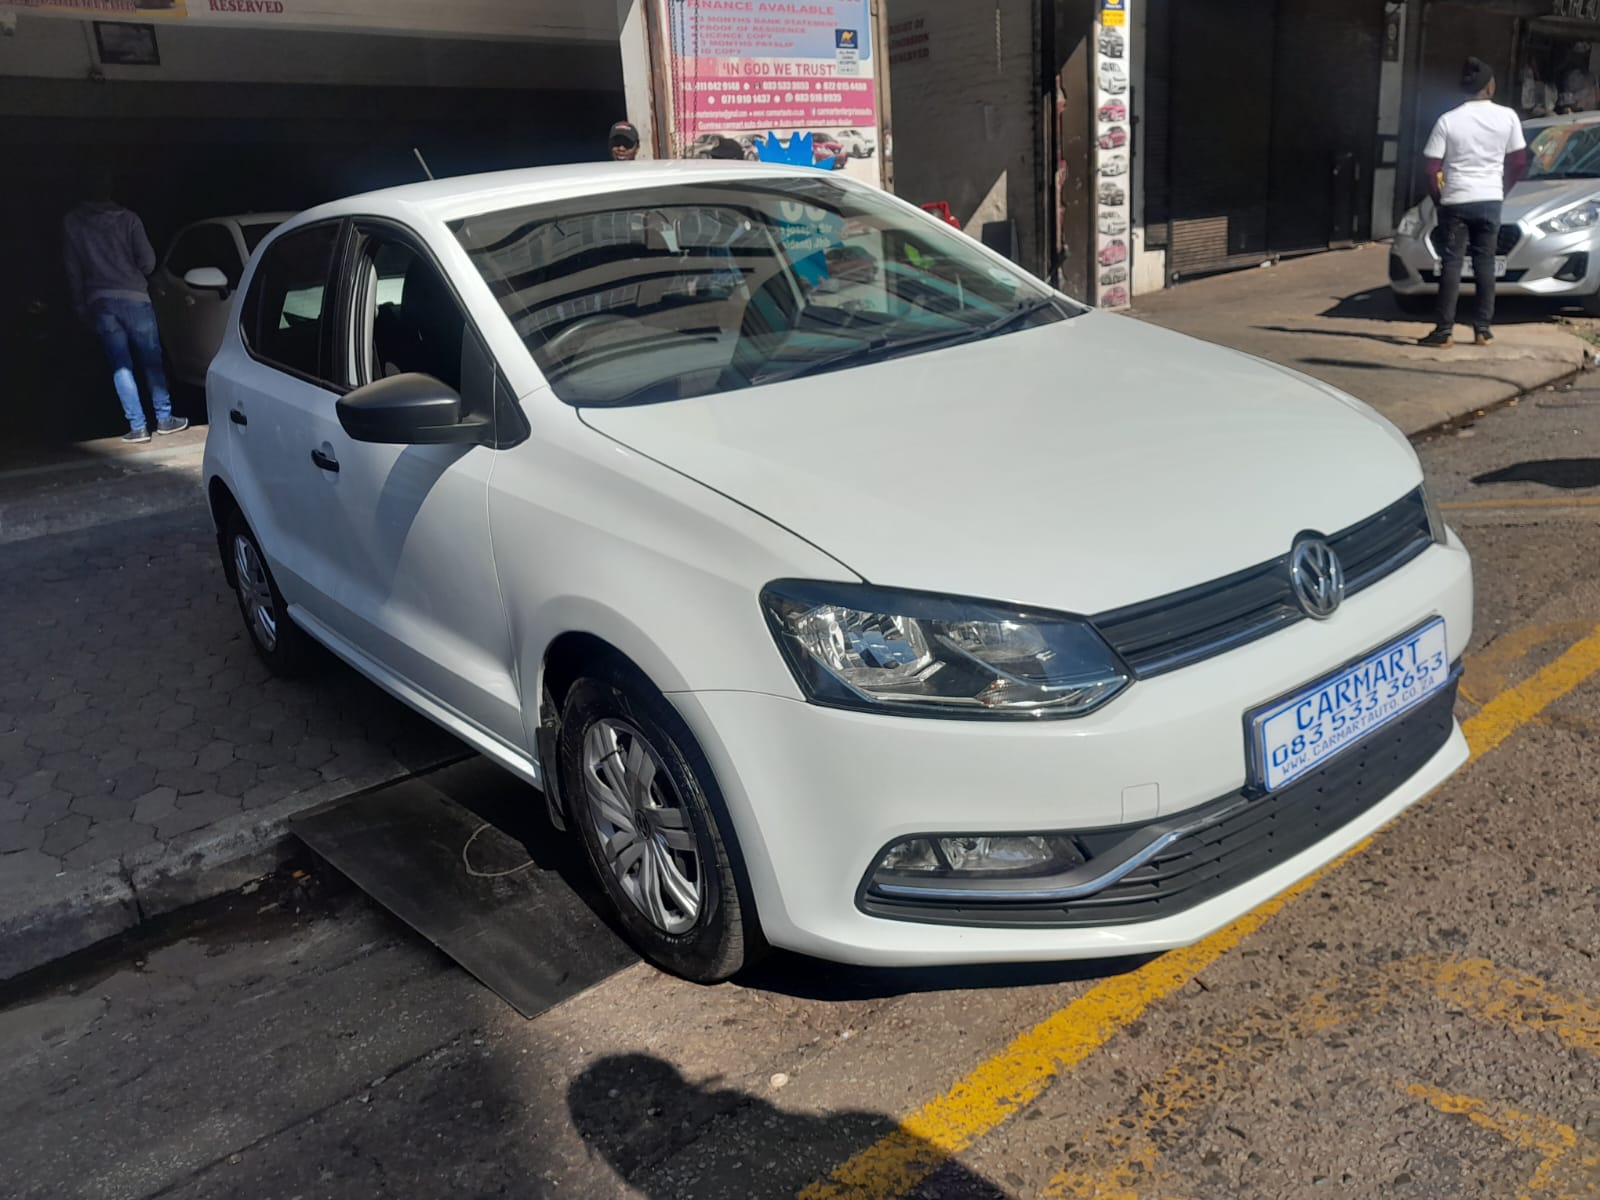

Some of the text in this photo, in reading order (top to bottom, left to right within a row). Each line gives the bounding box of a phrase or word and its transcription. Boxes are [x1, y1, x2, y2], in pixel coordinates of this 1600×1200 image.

[208, 0, 285, 13] RESERVED
[758, 3, 835, 16] AVAILABLE
[744, 63, 770, 75] GOD
[773, 64, 792, 75] WE
[1296, 638, 1421, 731] CARMART
[1272, 650, 1444, 768] 083 533 3653
